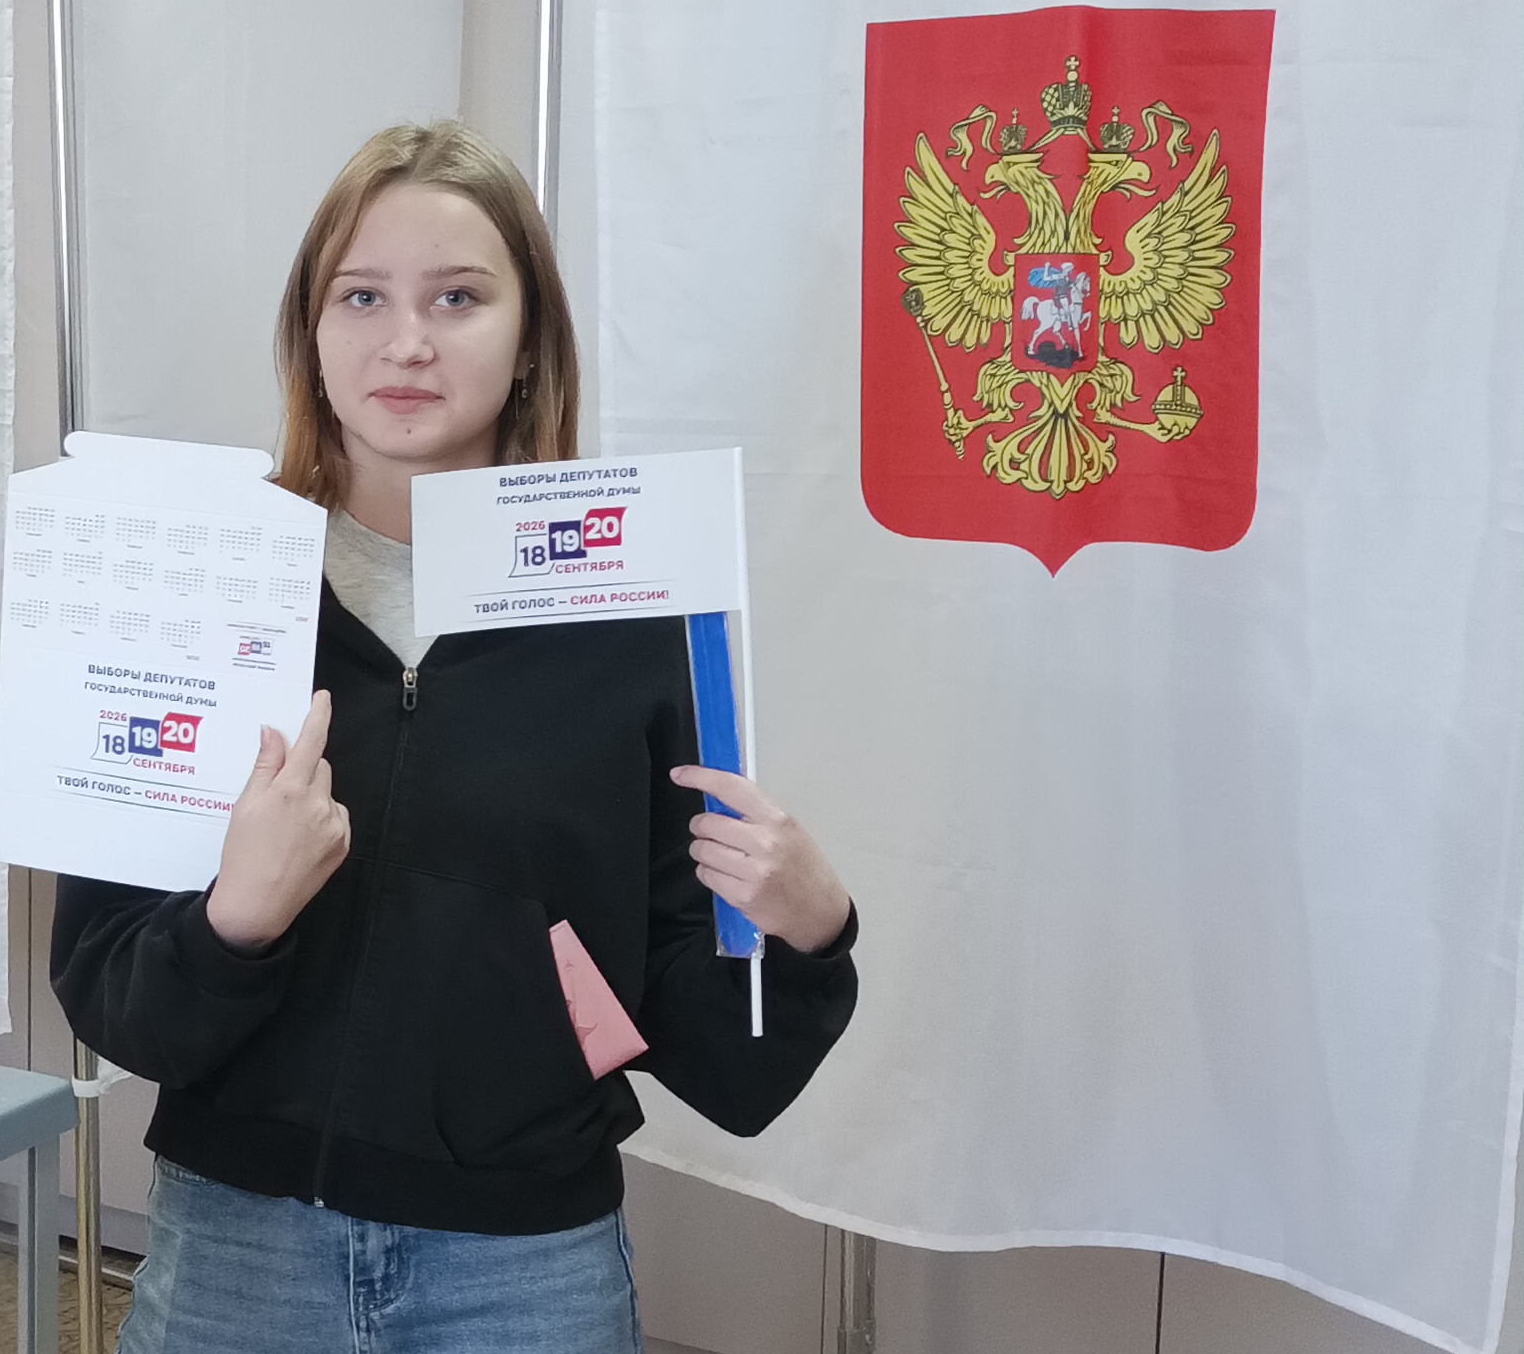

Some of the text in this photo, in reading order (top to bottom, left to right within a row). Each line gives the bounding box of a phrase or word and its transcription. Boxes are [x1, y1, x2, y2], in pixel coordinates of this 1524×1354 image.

[499, 467, 638, 488] ВЫБОРЫ ДЕПУТАТОВ
[497, 486, 641, 505] ГОСУДАРСТВЕННОЙ ДУМЫ
[515, 520, 545, 532] 2026
[520, 516, 620, 567] 18 19 20
[555, 560, 624, 574] СЕНТЯБРЯ
[474, 598, 509, 614] ТВОЙ
[511, 597, 555, 612] ГОЛОС
[570, 593, 606, 606] СИЛА
[88, 664, 216, 691] ВЫБОРЫ ДЕПУТАТОВ
[84, 681, 218, 708] ГОСУДАРСТВЕННОЙ ДУМЫ
[99, 709, 127, 722] 2026
[102, 720, 195, 755] 18 19 20
[133, 757, 195, 775] СЕНТЯБРЯ
[57, 775, 89, 789] ТВОЙ
[91, 781, 131, 796] ГОЛОС
[145, 790, 177, 803] СИЛА
